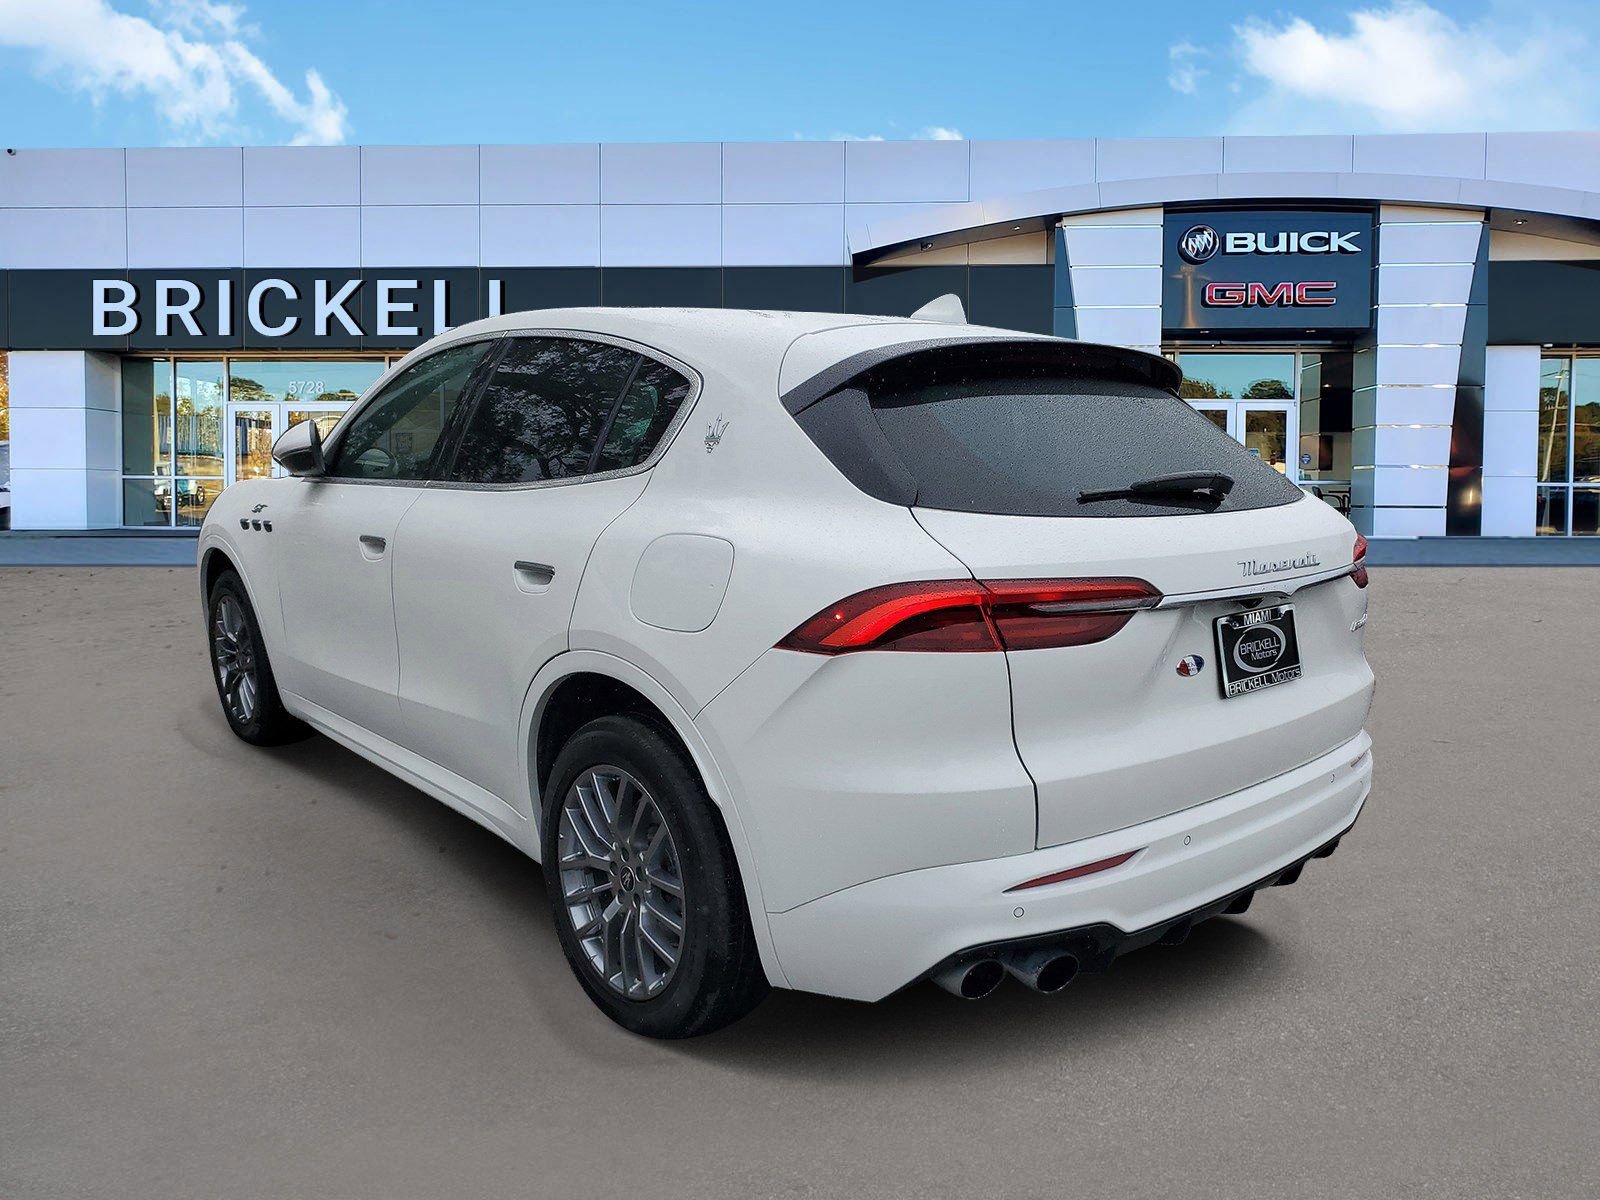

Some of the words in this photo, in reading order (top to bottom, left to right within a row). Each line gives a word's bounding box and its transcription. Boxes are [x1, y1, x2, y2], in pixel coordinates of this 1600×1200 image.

[1225, 231, 1361, 253] BUICK
[1204, 281, 1337, 306] GMC
[288, 380, 325, 394] 5728
[1243, 609, 1272, 626] MIAMI
[1240, 636, 1280, 655] BRICKELL
[1251, 648, 1278, 661] Motors
[1229, 675, 1269, 695] BRICKELL
[1272, 668, 1301, 683] Motors
